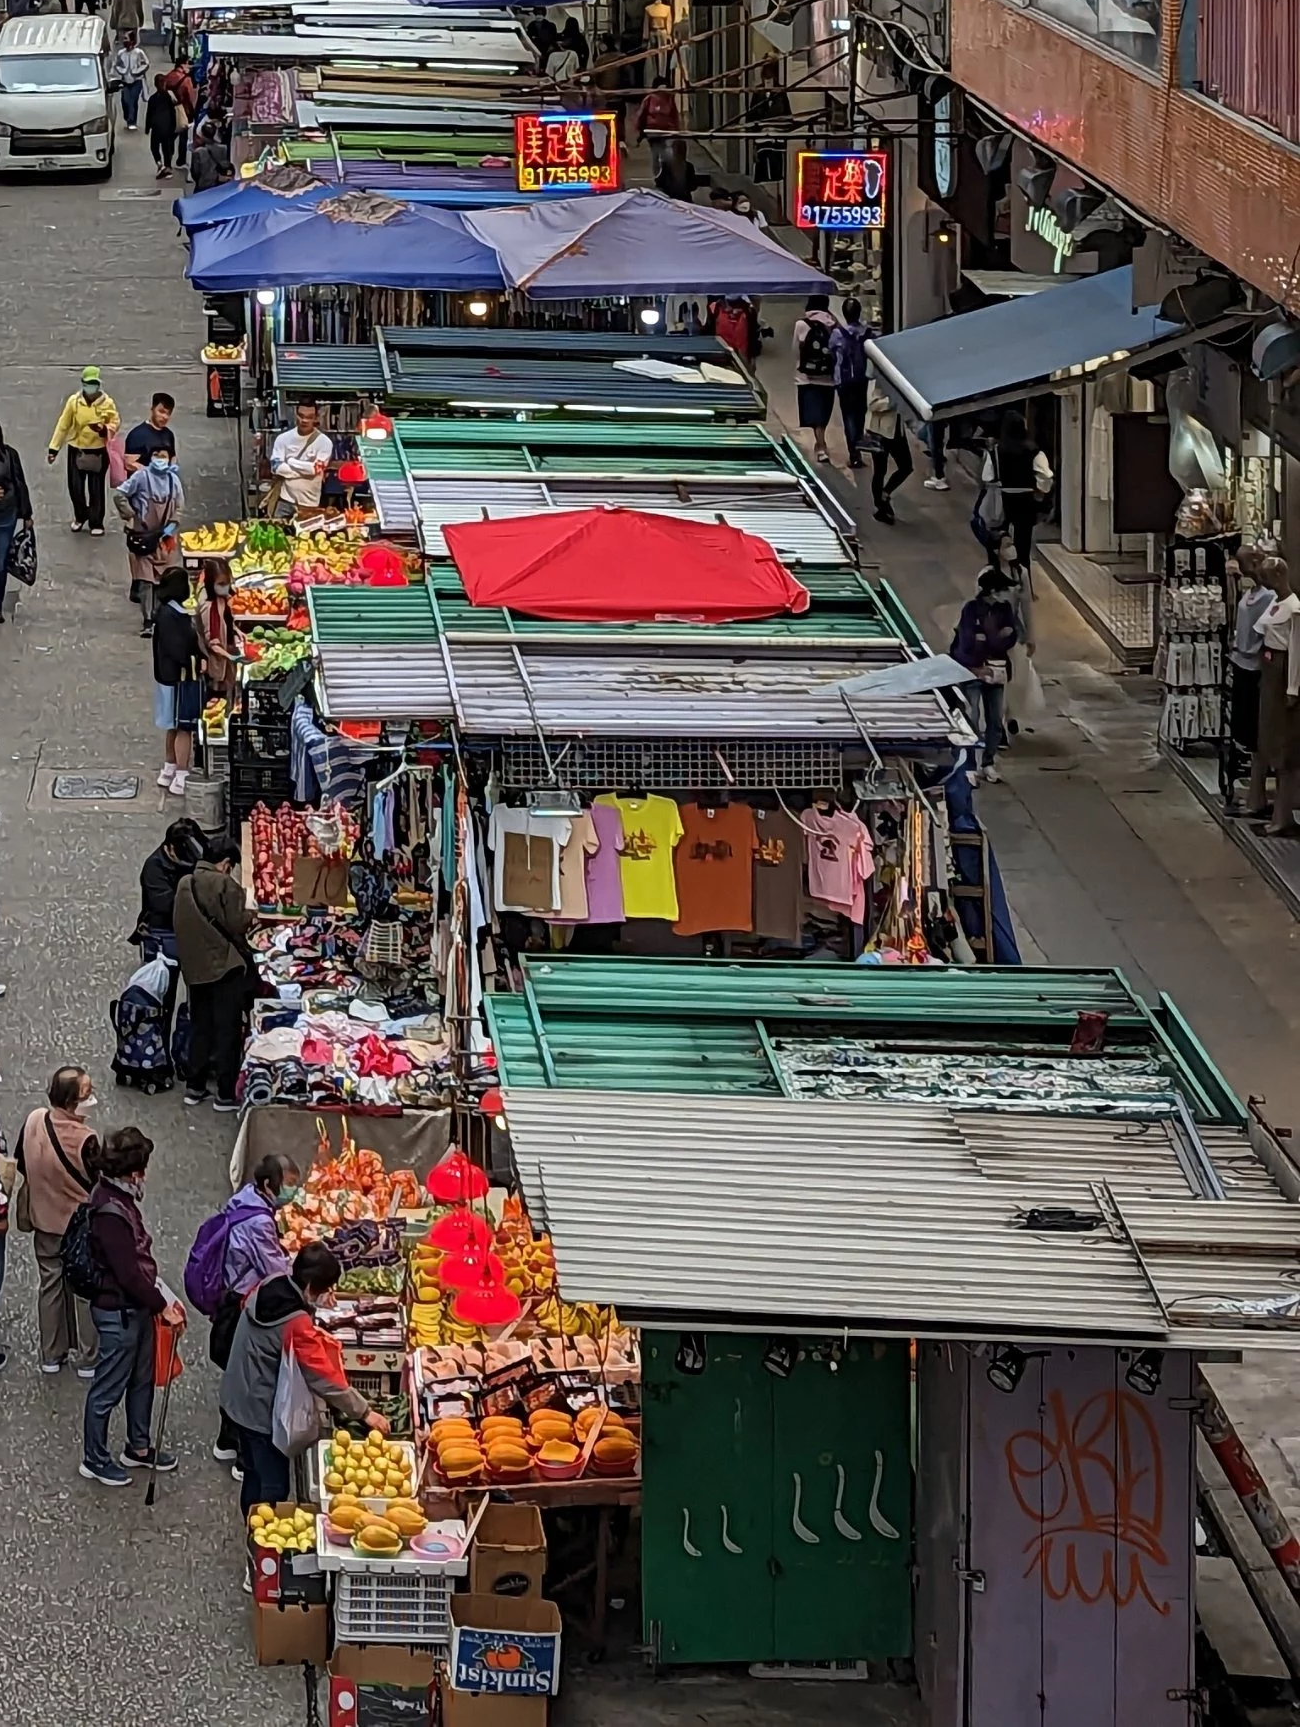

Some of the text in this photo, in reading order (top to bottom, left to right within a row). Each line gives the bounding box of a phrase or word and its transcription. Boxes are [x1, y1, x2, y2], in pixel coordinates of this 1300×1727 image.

[523, 166, 611, 185] 91755993
[802, 205, 881, 225] 91755993
[458, 1662, 552, 1693] Sunkist
